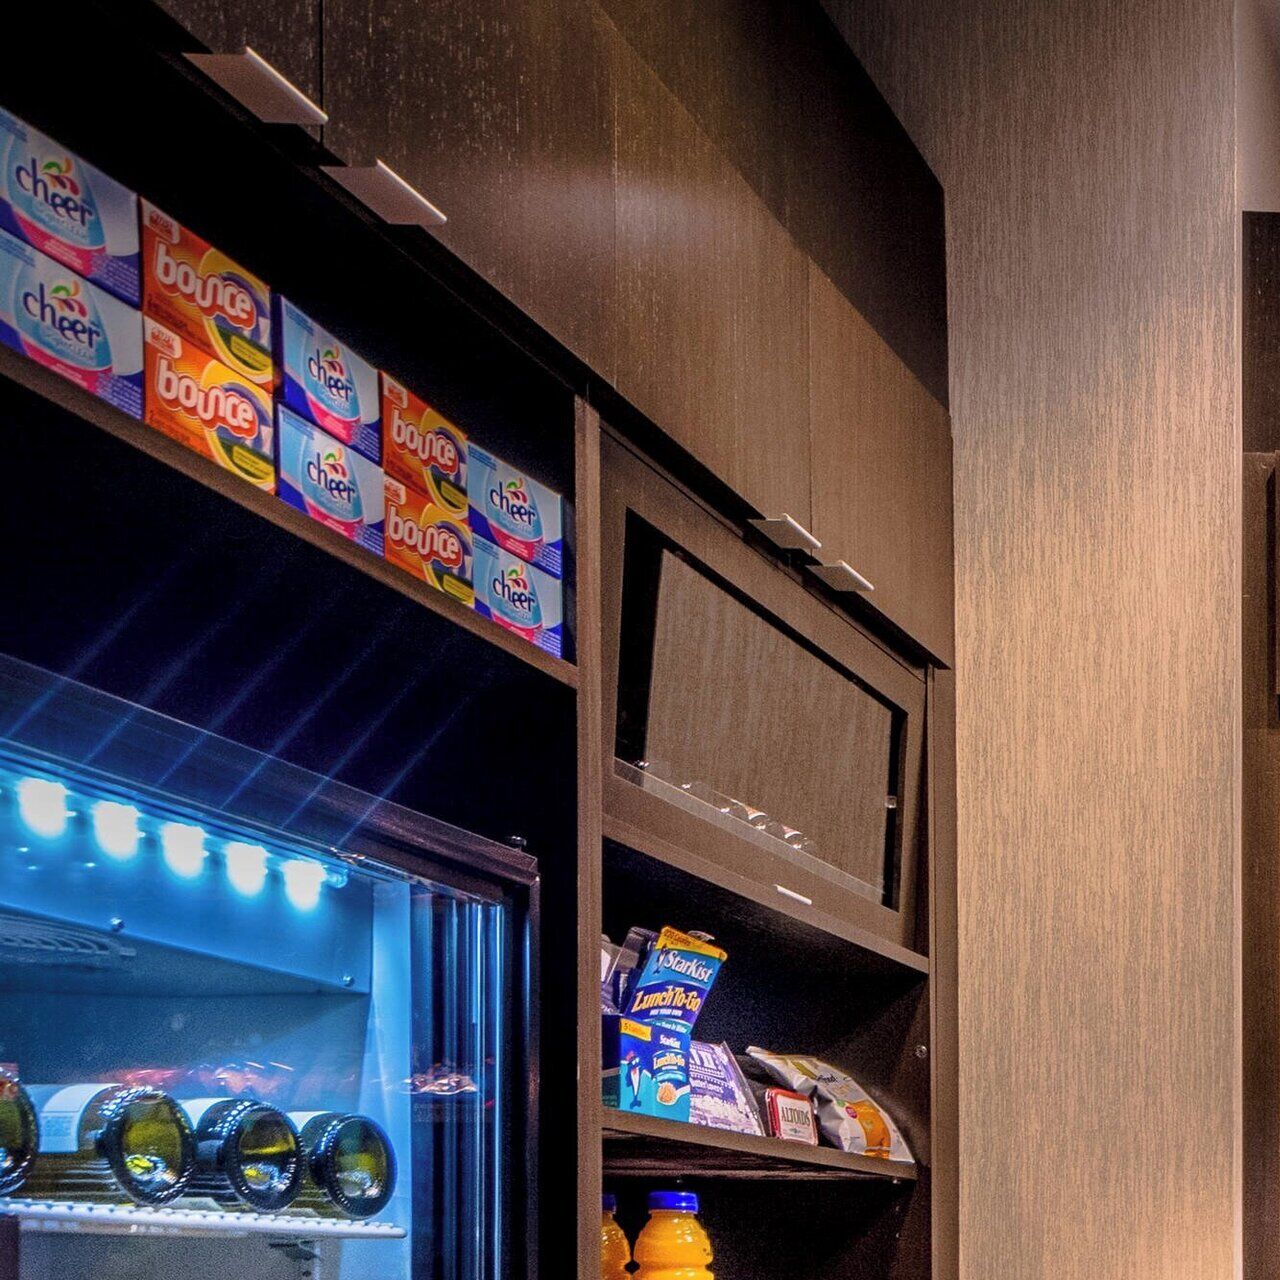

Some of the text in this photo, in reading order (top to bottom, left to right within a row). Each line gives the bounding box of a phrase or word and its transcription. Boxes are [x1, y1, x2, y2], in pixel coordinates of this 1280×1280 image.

[16, 158, 92, 226] cheer
[156, 242, 252, 320] bounce
[23, 283, 100, 348] cheer
[158, 358, 255, 428] bounce
[308, 350, 353, 402] cheer
[390, 408, 455, 467] bounce
[307, 452, 354, 503] cheer
[490, 481, 535, 526] cheer
[388, 505, 460, 560] bounce
[493, 566, 535, 612] cheer
[665, 951, 714, 983] StarKist
[632, 985, 701, 1013] Lunch To-Go
[781, 1106, 811, 1127] ALTOIDS
